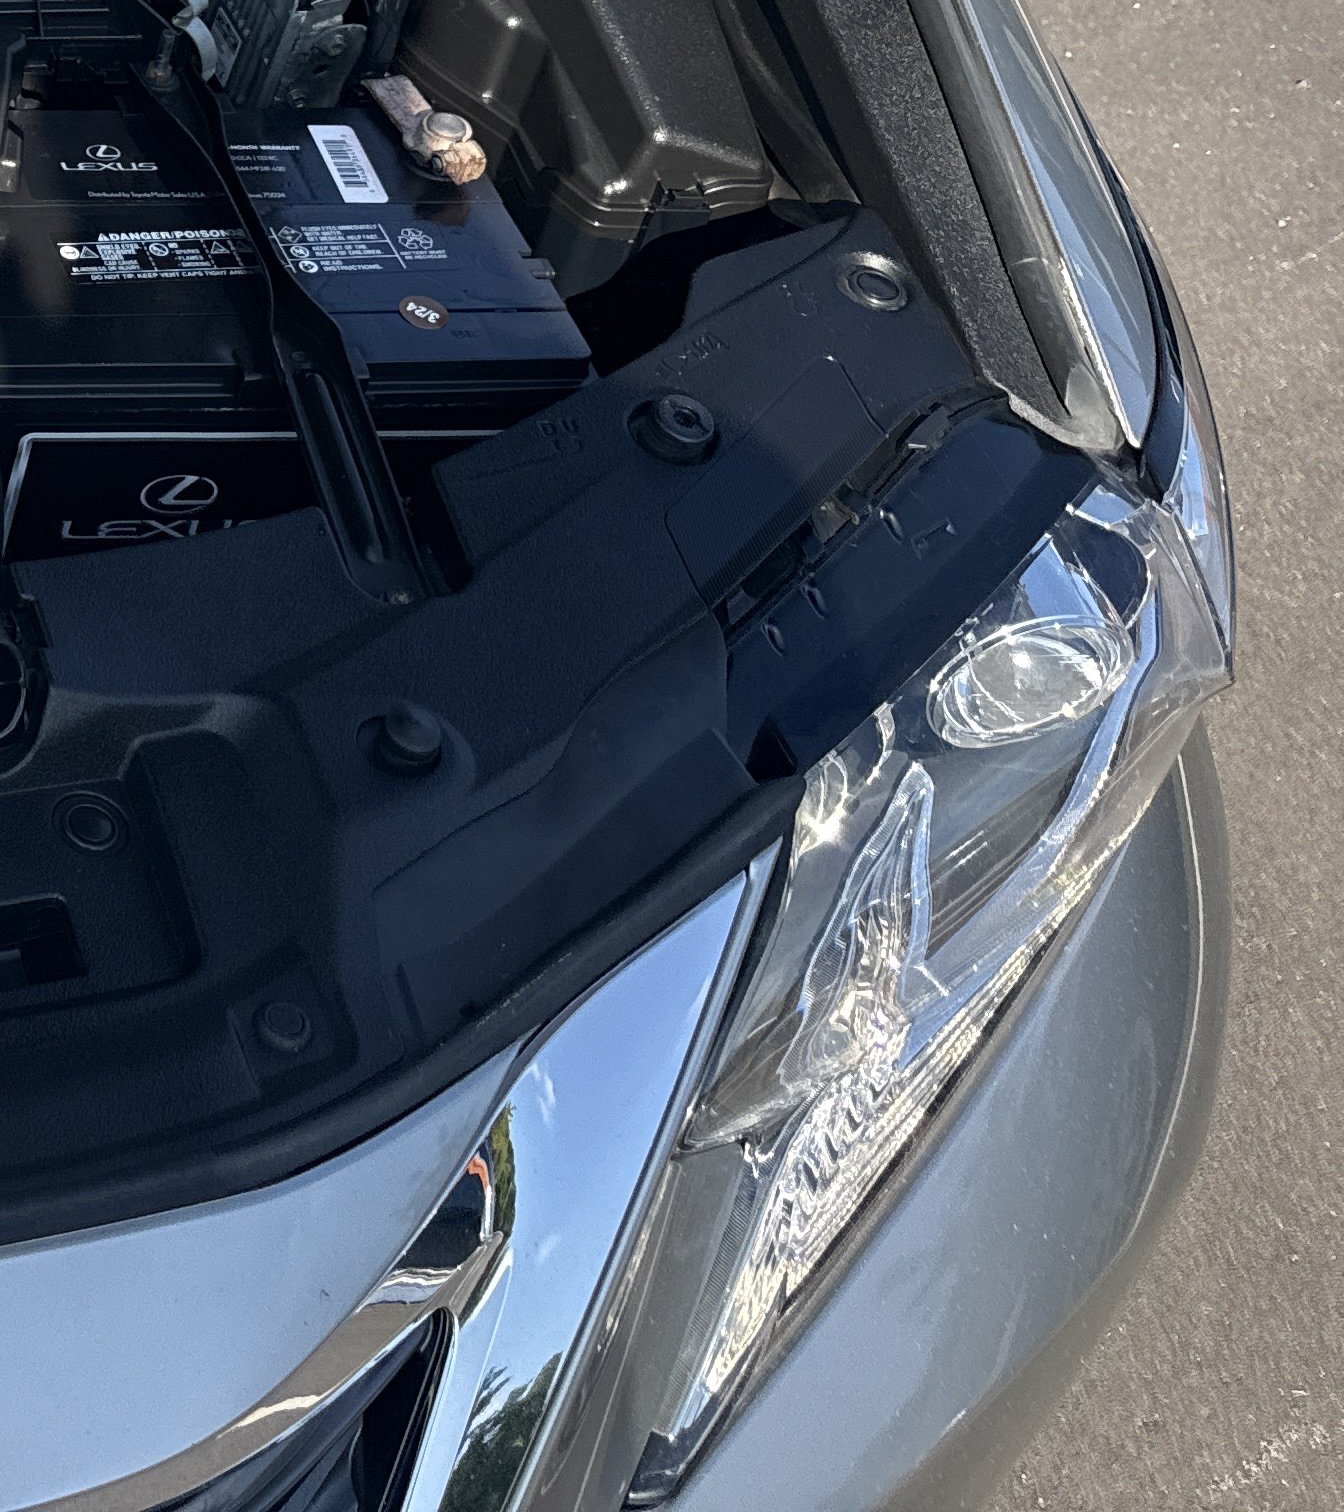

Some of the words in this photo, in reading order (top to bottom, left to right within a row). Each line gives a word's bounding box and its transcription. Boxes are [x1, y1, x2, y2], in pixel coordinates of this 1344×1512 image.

[60, 161, 159, 172] LEXUS
[137, 272, 159, 280] KEEP
[160, 271, 179, 279] VENT
[181, 270, 204, 278] CAPS
[405, 302, 440, 324] 3/24
[62, 519, 256, 539] LEXU
